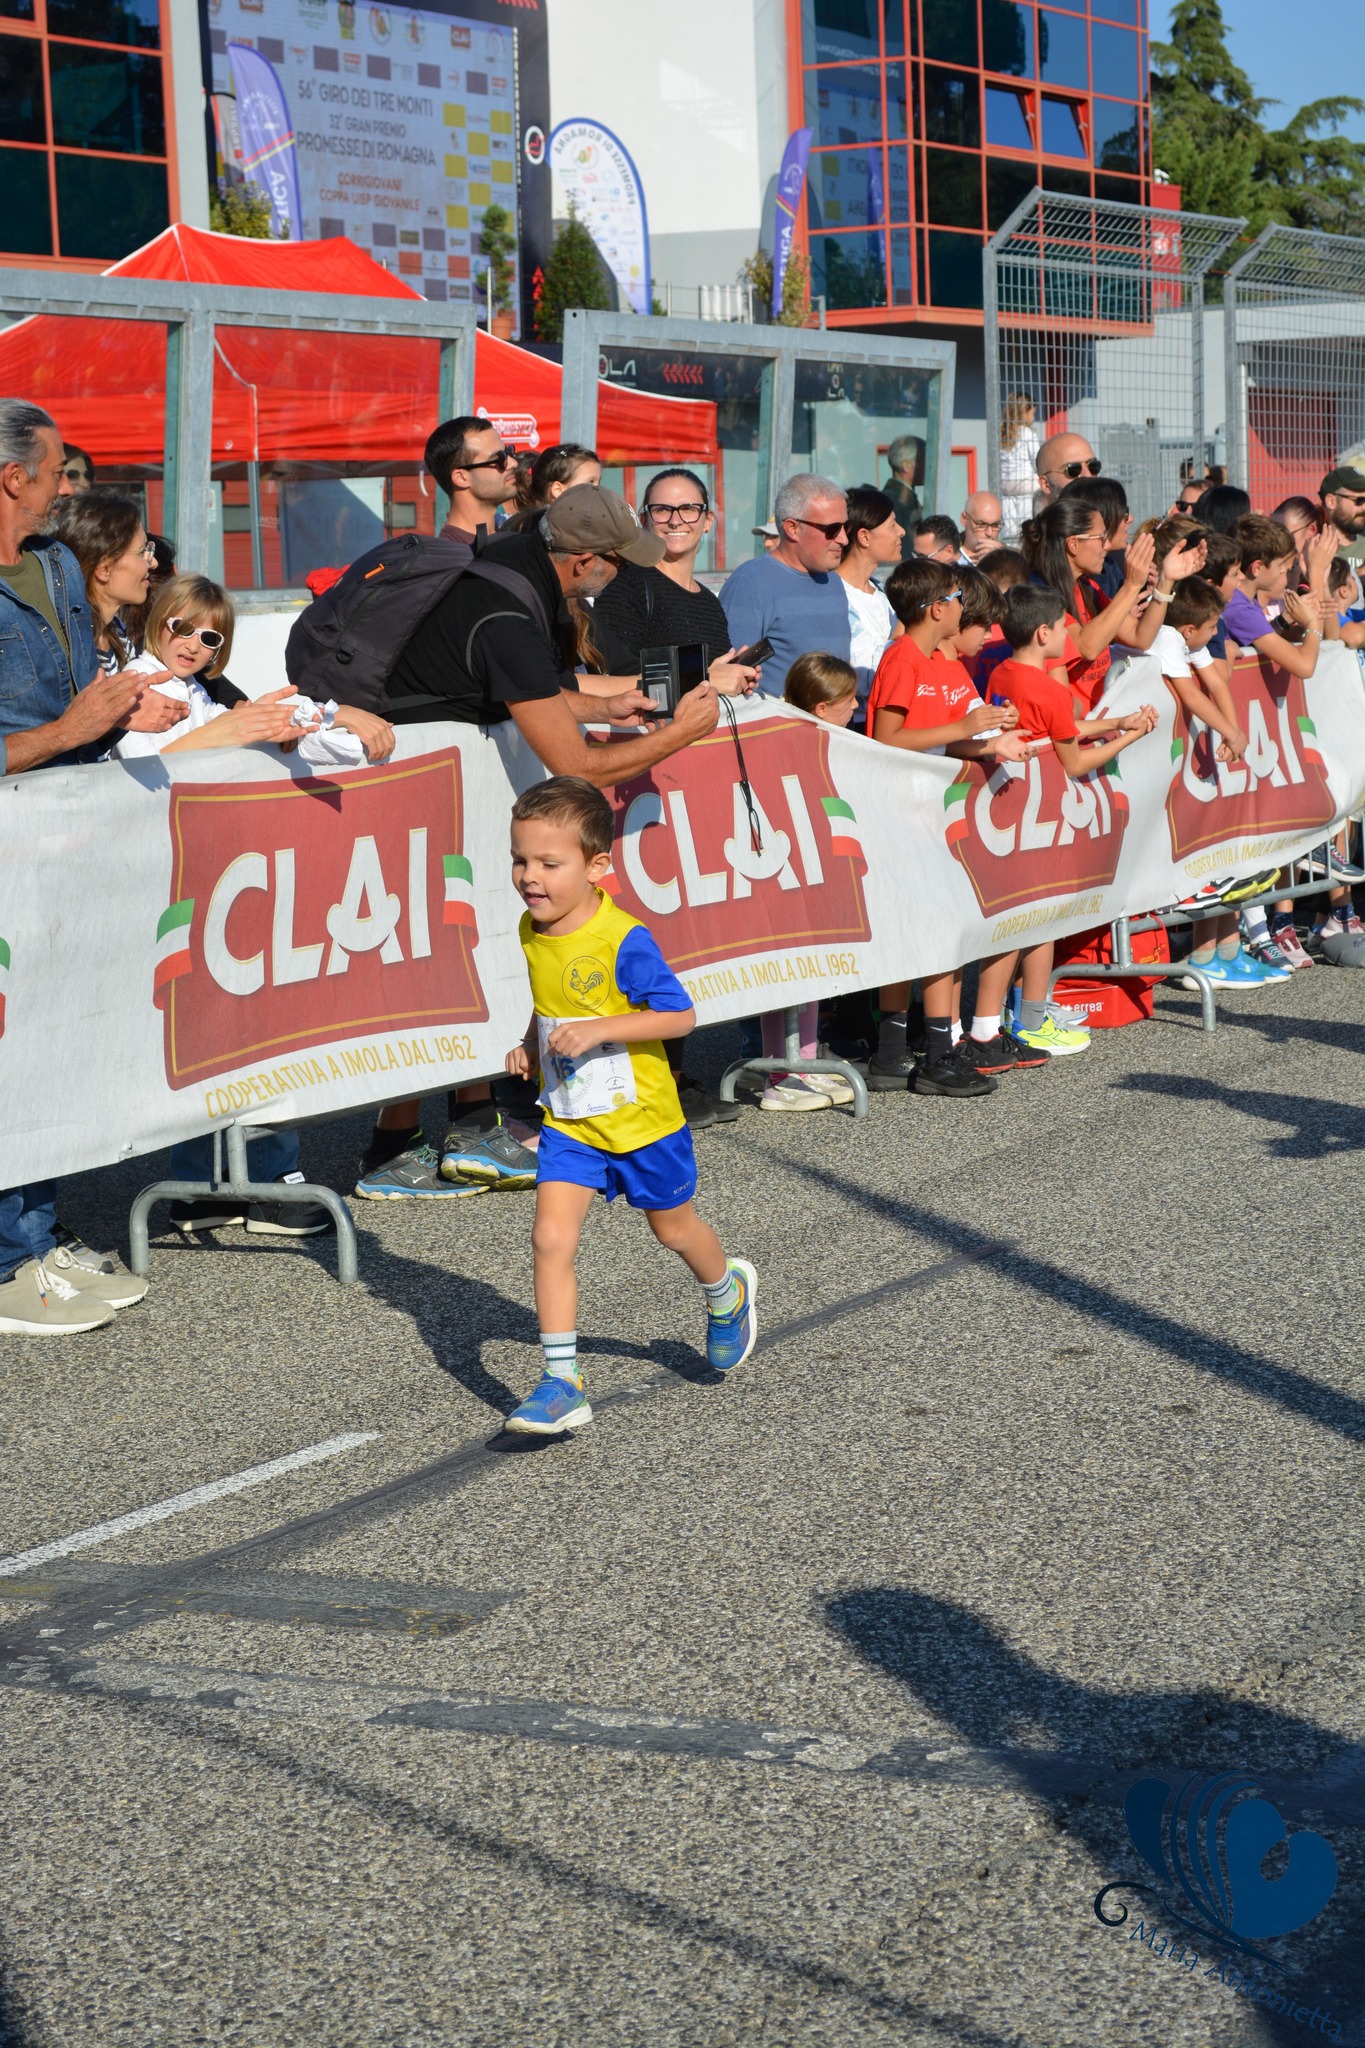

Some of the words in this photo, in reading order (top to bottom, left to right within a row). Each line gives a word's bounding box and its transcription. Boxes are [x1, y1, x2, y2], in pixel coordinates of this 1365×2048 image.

[319, 83, 349, 104] GIRO
[352, 88, 370, 108] DEI
[373, 91, 395, 112] TRE
[397, 95, 434, 117] MONTI
[346, 116, 372, 134] GRAN
[373, 119, 407, 138] PREMIO
[297, 131, 360, 159] PROMESSE
[362, 140, 376, 159] DI
[377, 141, 437, 166] ROMAGNA
[1183, 696, 1305, 803] CLAI
[975, 741, 1111, 857] CLAI
[622, 774, 824, 915] CLAI
[203, 827, 432, 995] CLAI
[991, 907, 1049, 943] COOPERATIVA
[683, 970, 740, 1003] RATIVA
[739, 966, 753, 989] A
[751, 959, 792, 987] IMOLA
[796, 955, 826, 979] DAL
[826, 953, 860, 976] 1962
[205, 1058, 329, 1119] COOPERATIVA
[326, 1055, 344, 1080] A
[340, 1043, 400, 1077] IMOLA
[397, 1039, 436, 1067] DAL
[434, 1034, 477, 1062] 1962
